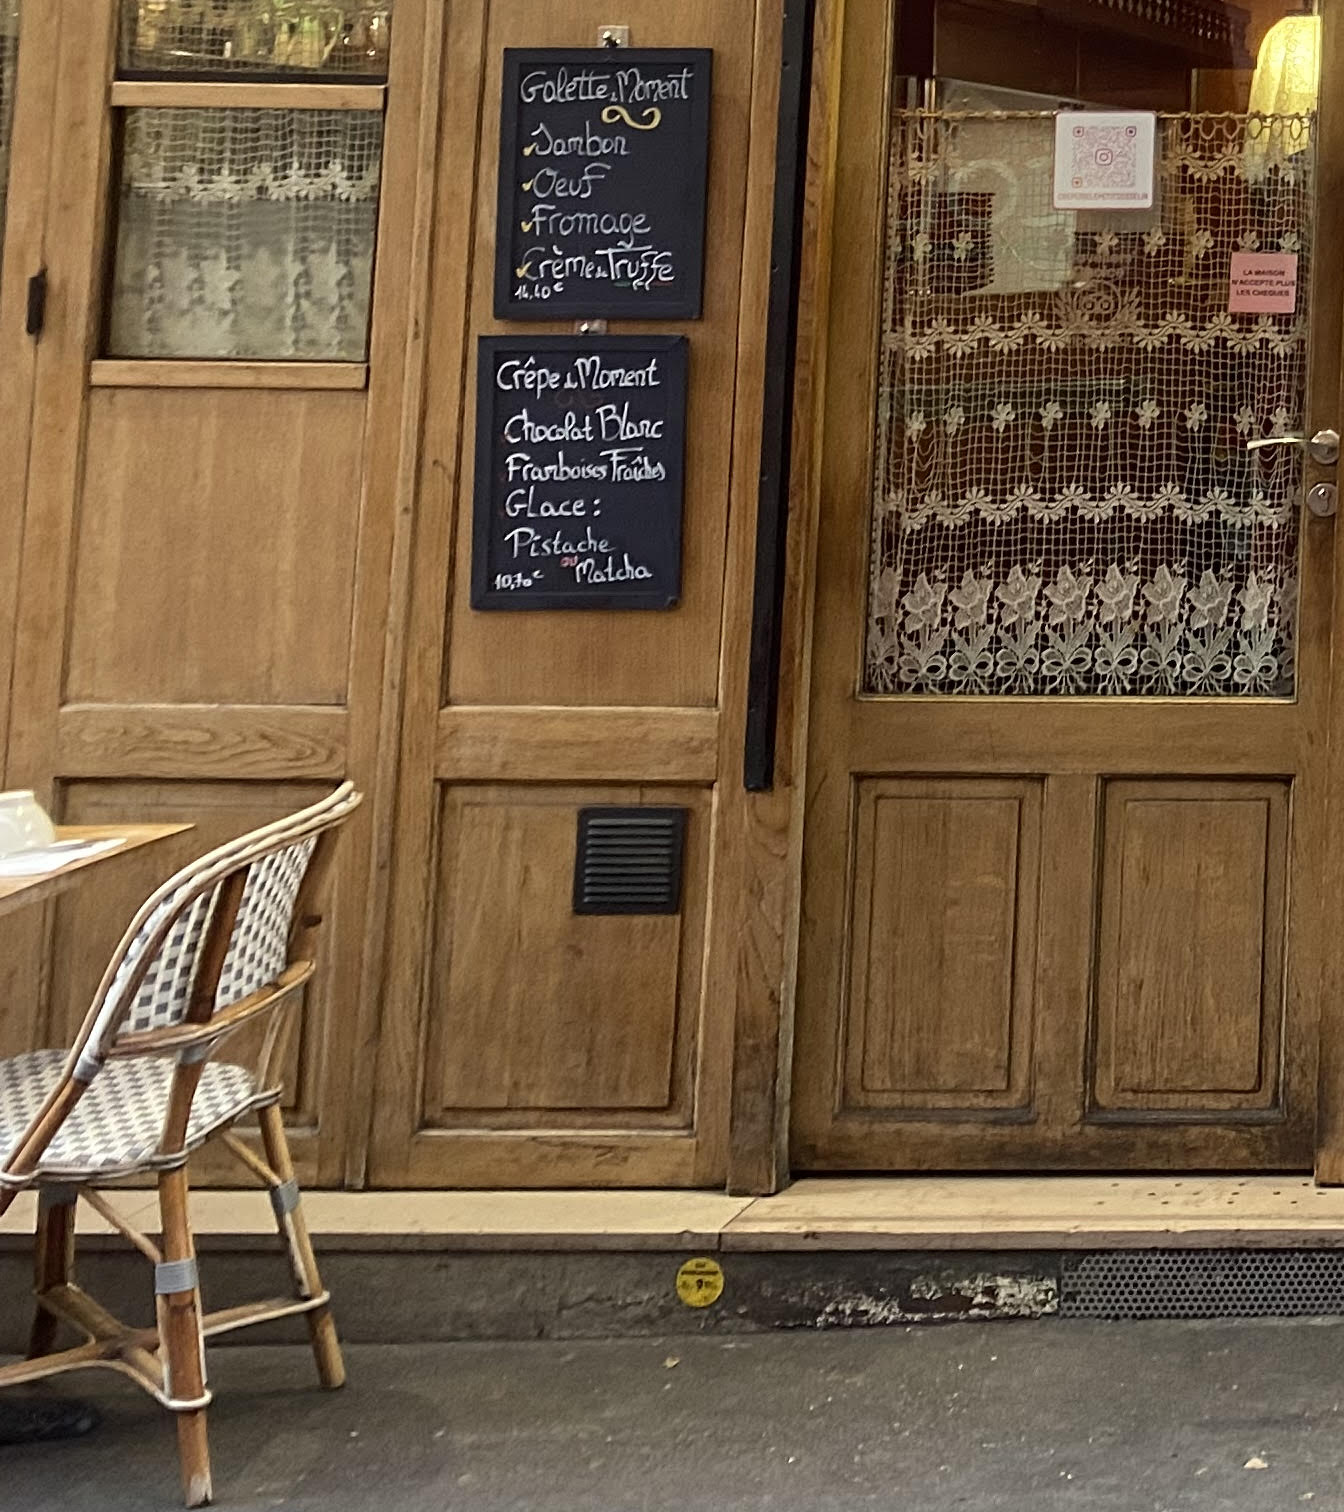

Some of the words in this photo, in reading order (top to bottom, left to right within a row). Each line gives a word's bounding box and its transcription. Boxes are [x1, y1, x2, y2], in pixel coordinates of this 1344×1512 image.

[520, 66, 610, 103] Galette
[616, 67, 694, 103] Moment
[531, 120, 630, 156] Jambon
[532, 162, 611, 199] Oeuf
[530, 204, 651, 249] Fromage
[521, 244, 592, 281] Crème
[595, 245, 675, 290] Truffe
[496, 355, 560, 399] Crêpe
[575, 356, 660, 389] Moment
[504, 408, 594, 443] Chocolat
[596, 401, 664, 441] Blanc
[504, 451, 608, 482] Framboises
[504, 526, 616, 558] Pistache
[575, 553, 653, 584] Matcha
